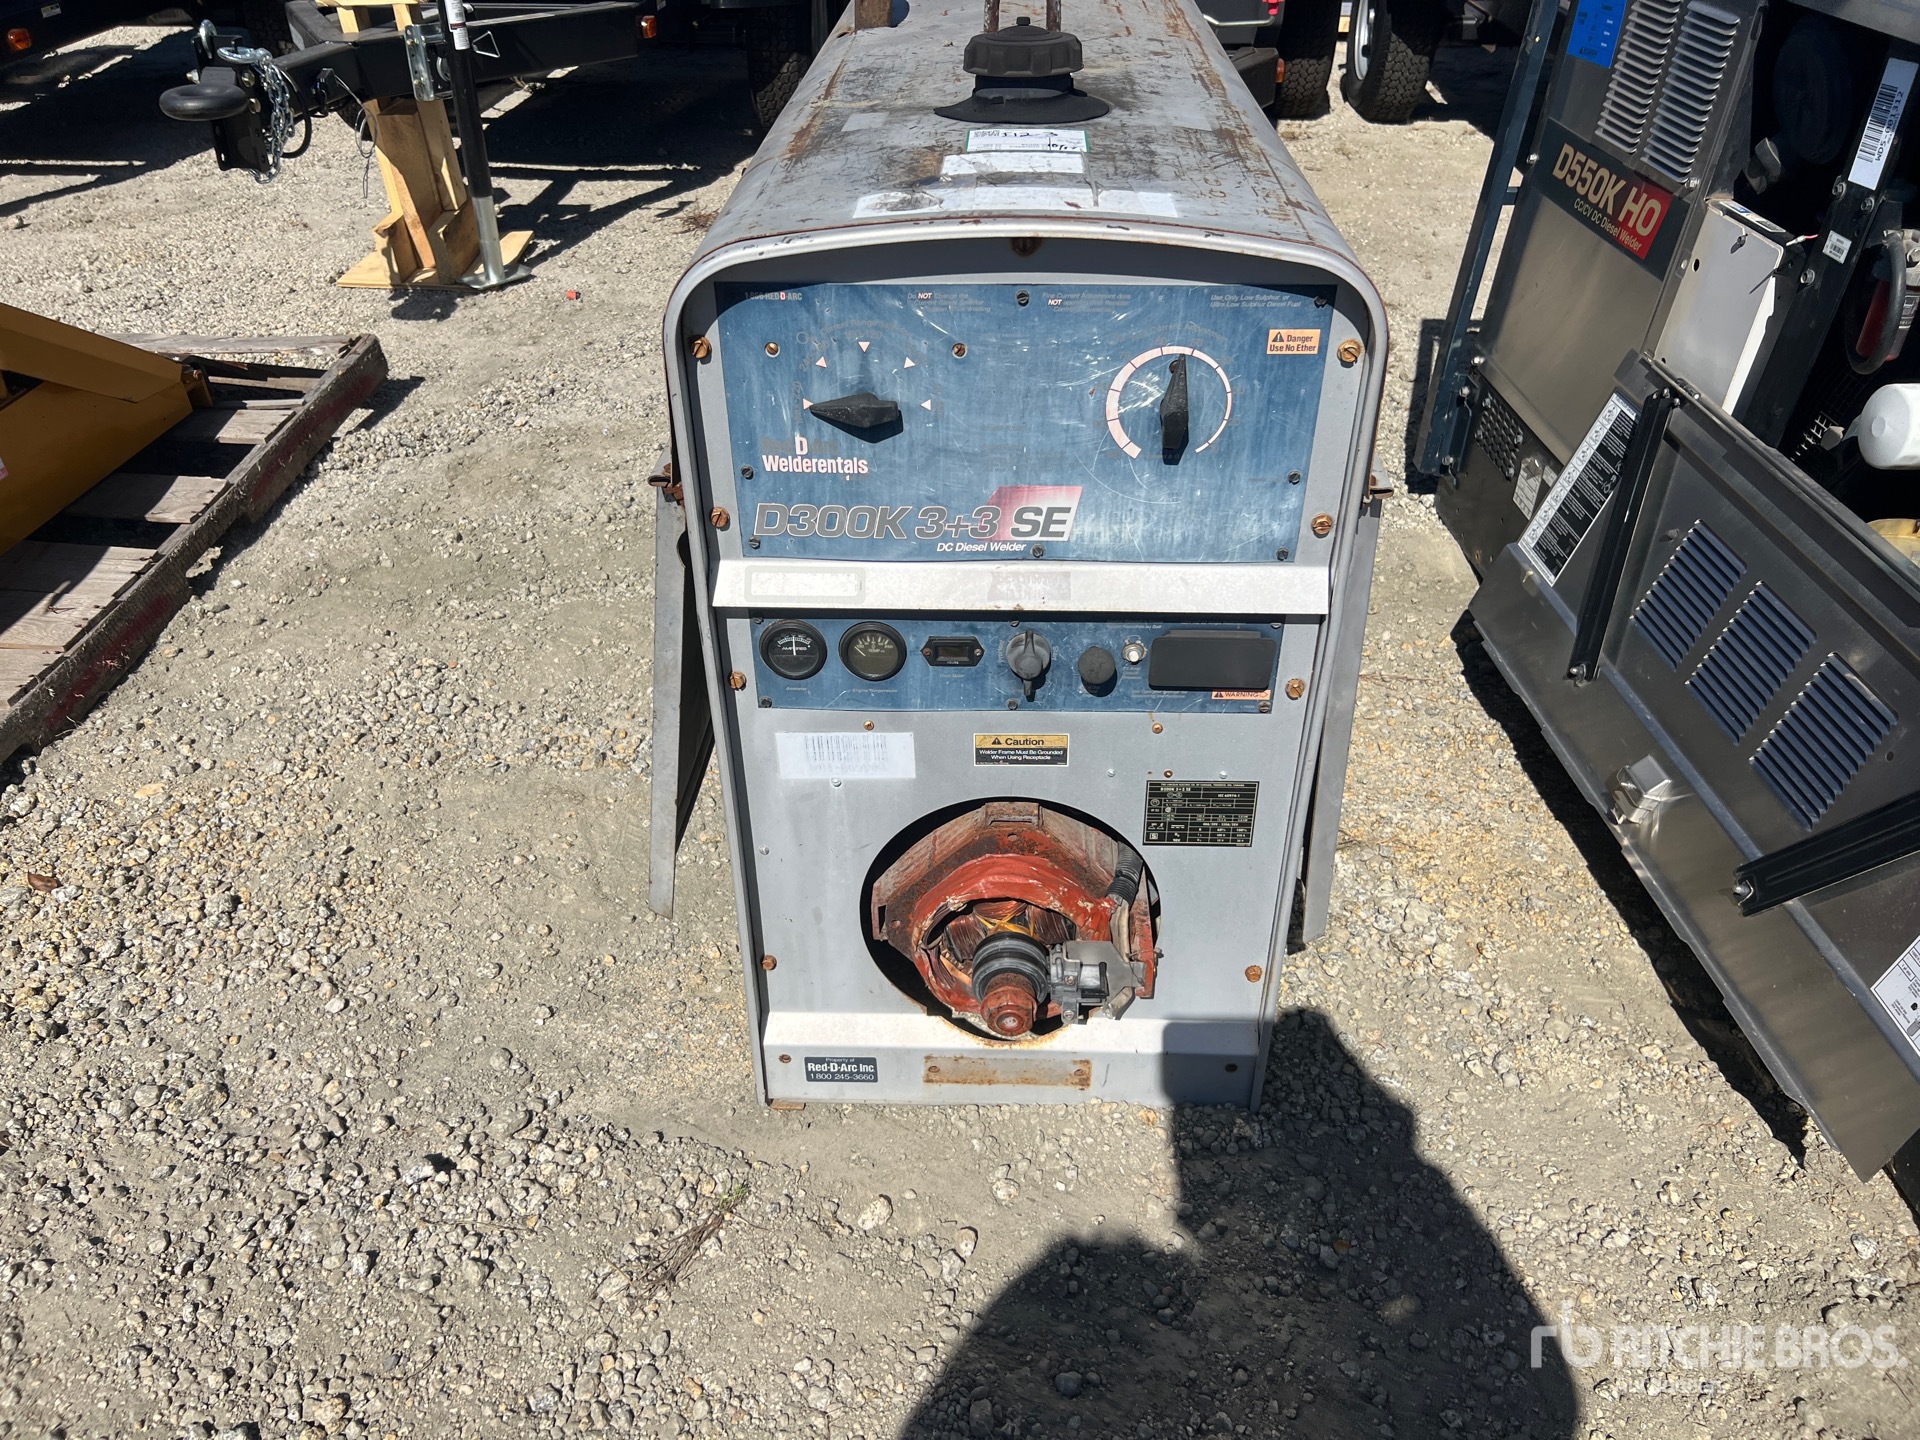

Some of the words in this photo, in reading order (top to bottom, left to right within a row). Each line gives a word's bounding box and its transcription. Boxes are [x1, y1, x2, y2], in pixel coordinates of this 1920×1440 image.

[1552, 142, 1627, 217] D550K
[1617, 187, 1662, 237] HO
[1573, 197, 1592, 217] CC/CV
[1590, 211, 1601, 225] DC
[1600, 217, 1621, 237] Diesel
[1618, 229, 1642, 252] Welder
[917, 292, 933, 300] NOT
[1287, 334, 1314, 344] Danger
[1269, 344, 1284, 352] Use
[1285, 344, 1295, 352] No
[1296, 344, 1317, 352] Ether
[761, 454, 869, 474] Welderentals
[753, 502, 913, 540] D300K
[914, 505, 1001, 541] 3+3
[1010, 505, 1072, 539] SE
[936, 542, 954, 553] DC
[955, 542, 988, 553] Diesel
[989, 542, 1027, 553] Welder
[1005, 737, 1045, 746] Caution
[859, 1063, 875, 1072] Inc
[834, 1073, 875, 1081] 245-3660
